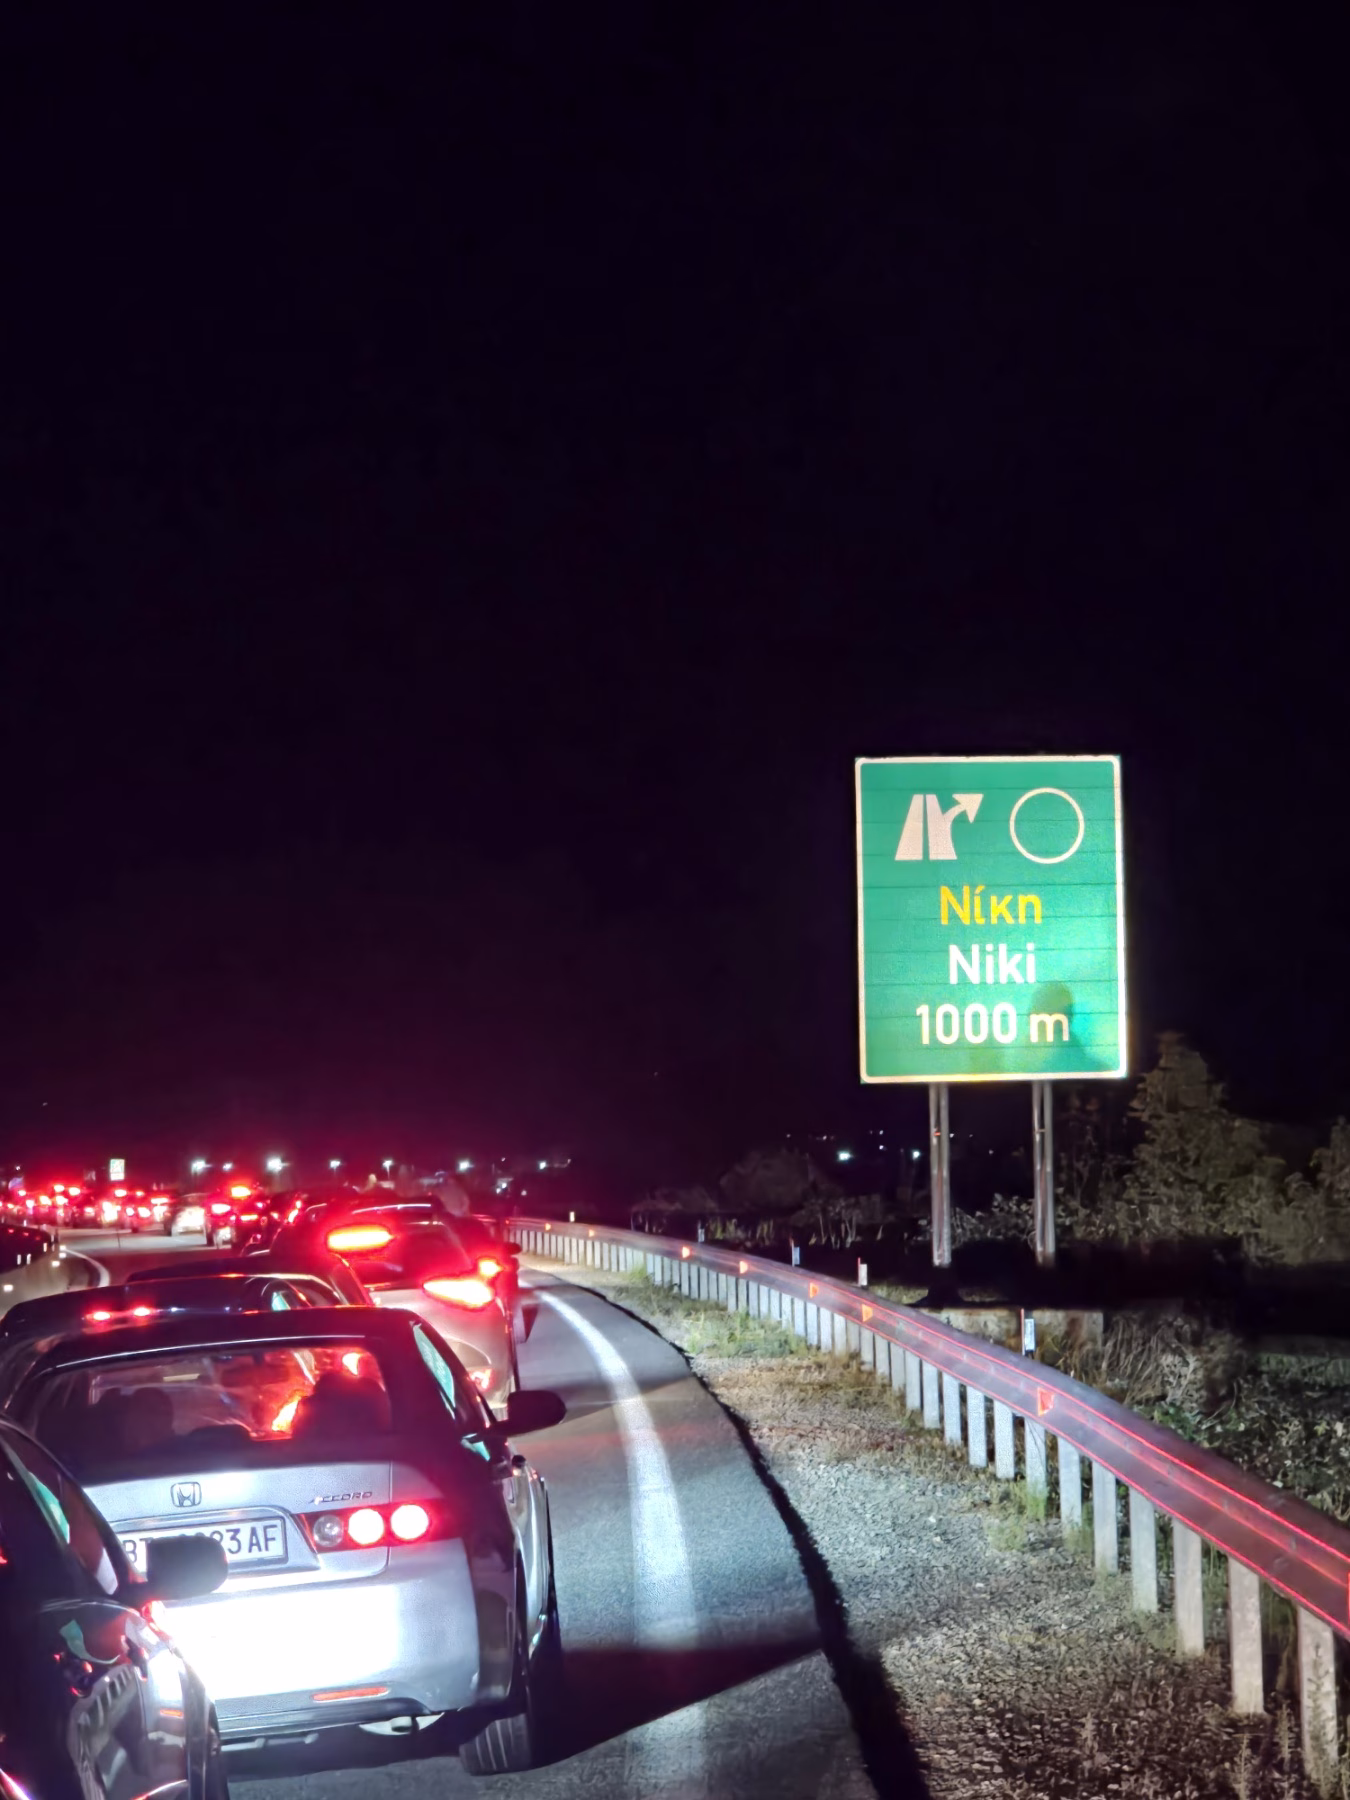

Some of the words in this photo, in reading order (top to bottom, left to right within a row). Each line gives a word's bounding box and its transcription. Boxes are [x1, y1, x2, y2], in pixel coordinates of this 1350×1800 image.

[948, 942, 1037, 985] Niki
[915, 1002, 1018, 1045] 1000
[1029, 1012, 1070, 1043] m
